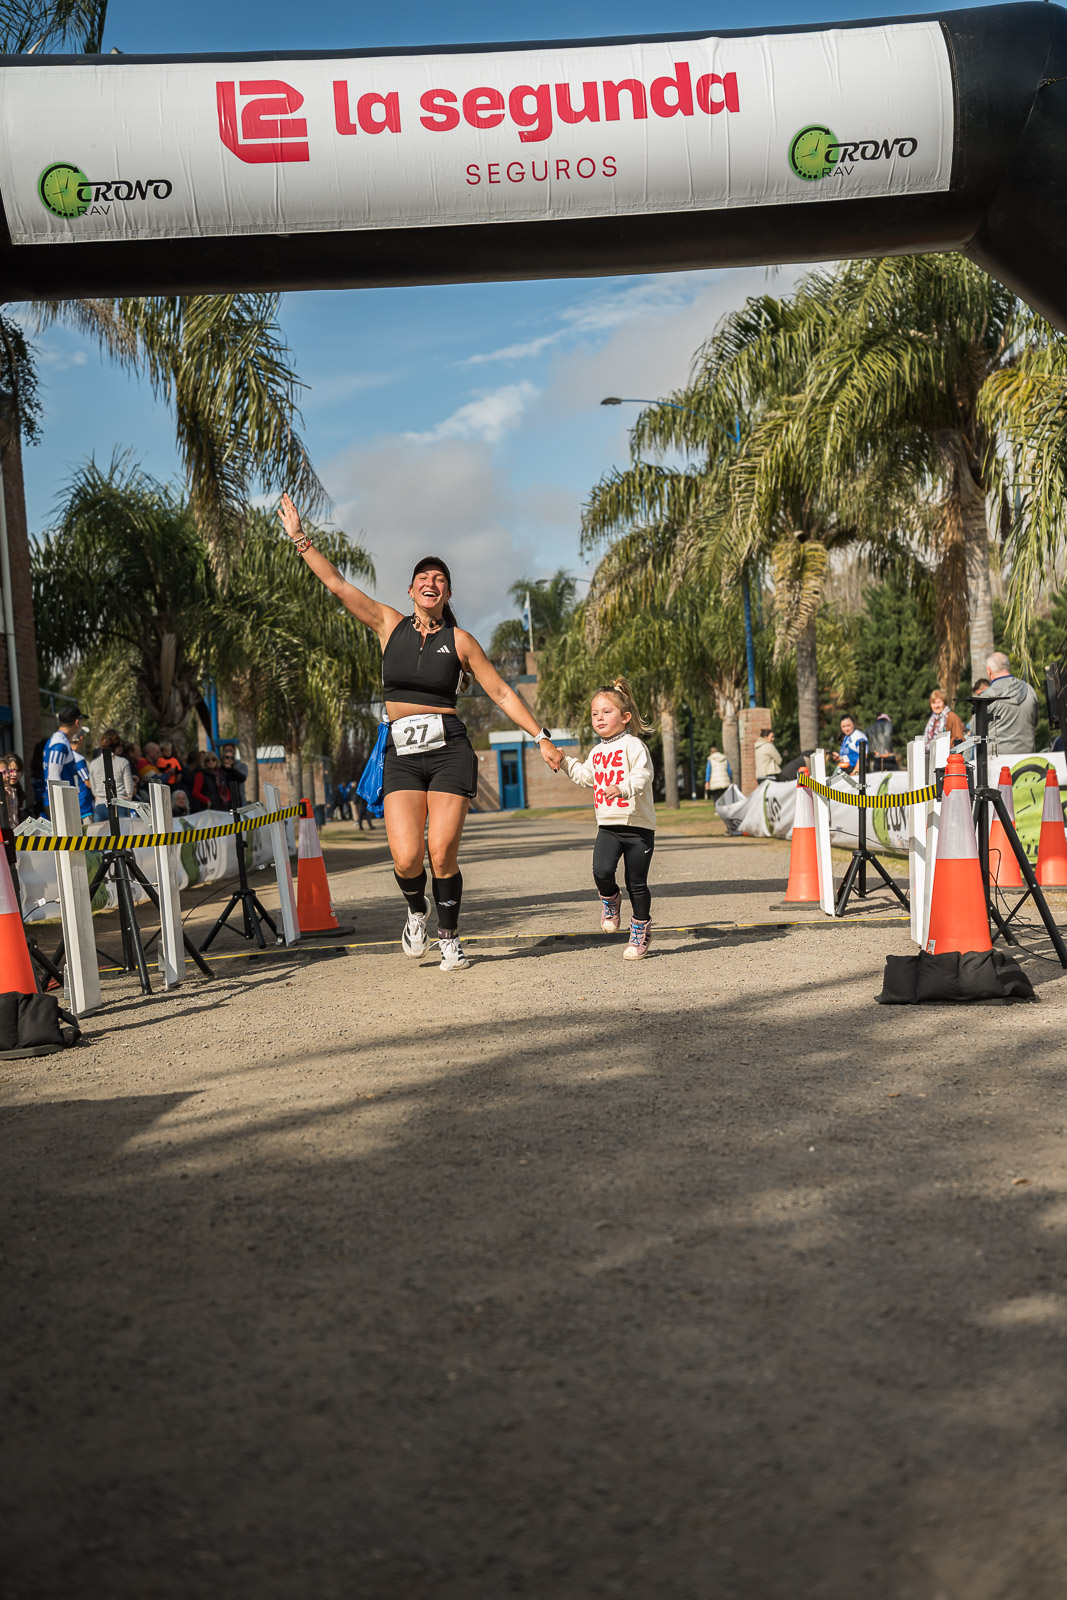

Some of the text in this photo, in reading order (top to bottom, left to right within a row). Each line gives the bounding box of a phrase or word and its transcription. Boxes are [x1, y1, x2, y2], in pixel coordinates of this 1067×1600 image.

[332, 61, 741, 143] la segunda
[824, 137, 918, 164] CRONO
[465, 155, 619, 186] SEGUROS
[821, 165, 855, 178] RAV
[76, 179, 173, 203] CRONO
[76, 204, 111, 217] RAV
[403, 723, 429, 746] 27
